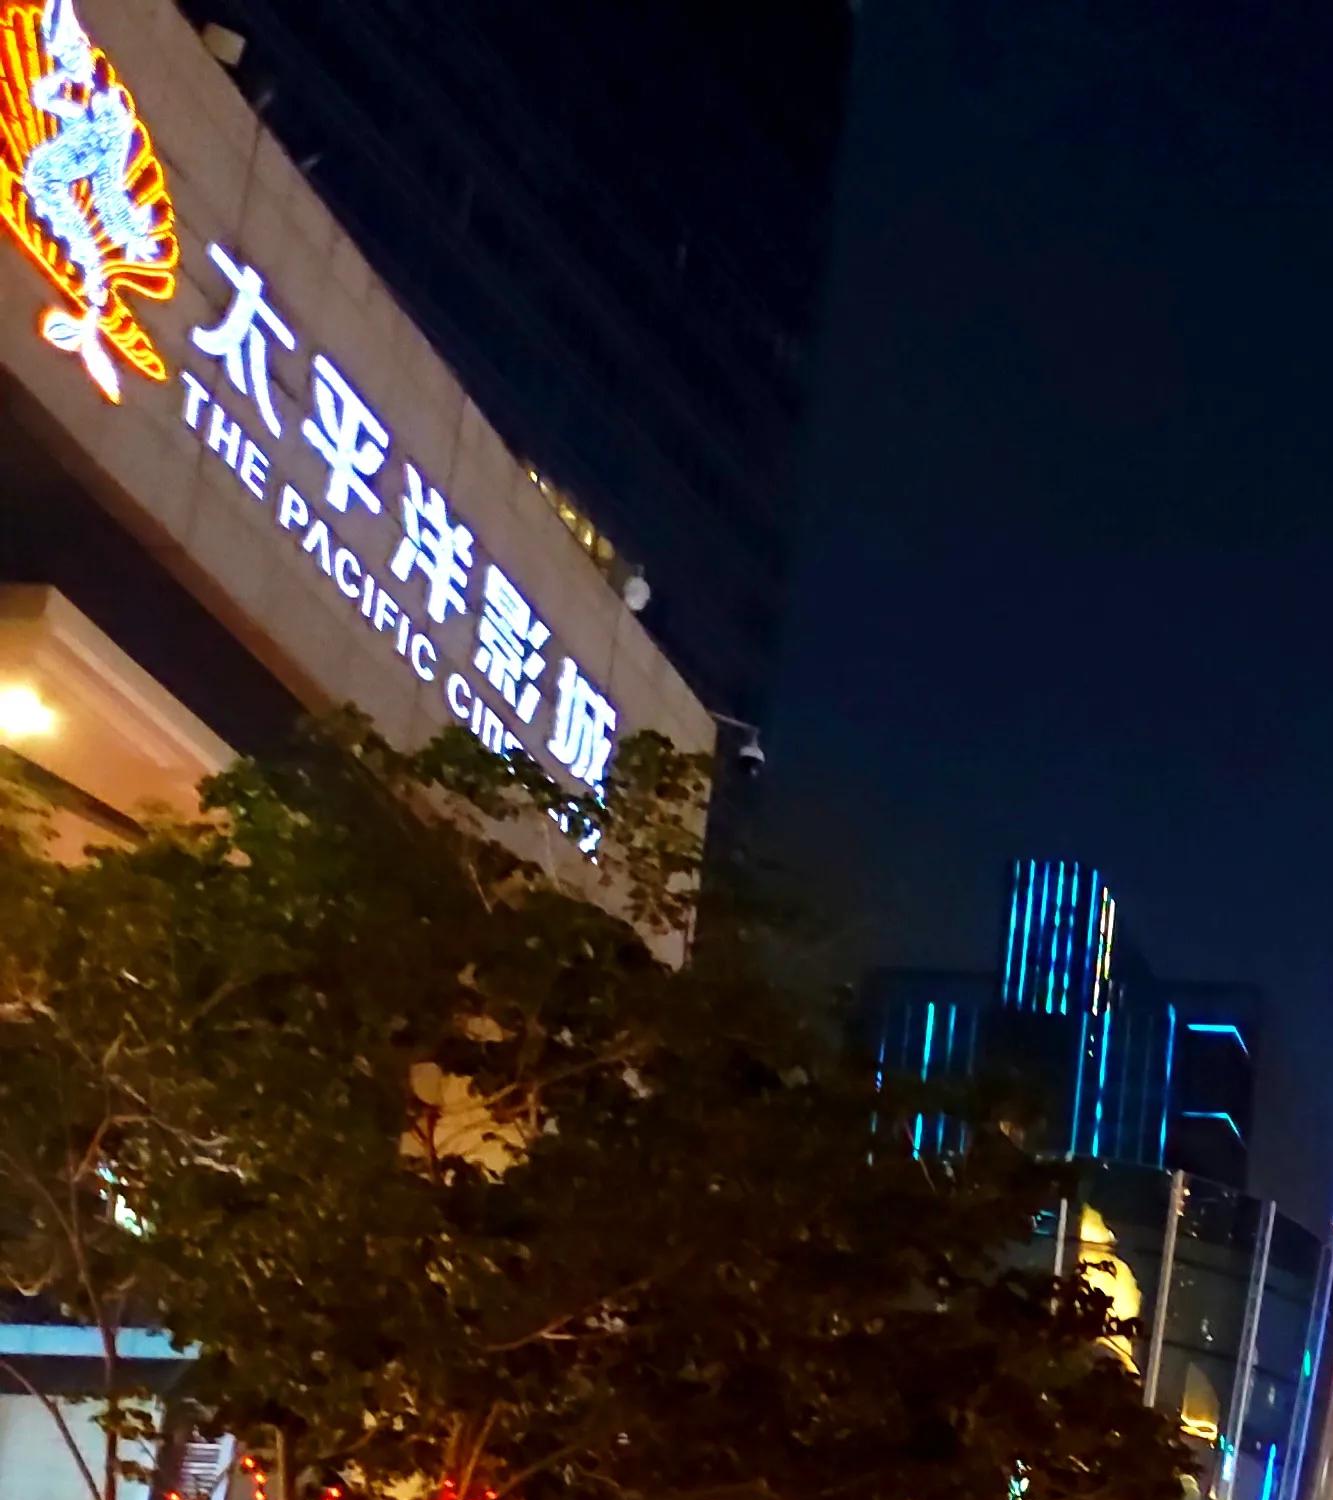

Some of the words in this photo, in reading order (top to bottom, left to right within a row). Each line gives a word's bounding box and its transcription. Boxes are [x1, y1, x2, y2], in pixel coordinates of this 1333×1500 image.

[180, 370, 271, 501] THE
[278, 483, 438, 683] PACIFIC
[190, 241, 617, 808] 太平洋影城
